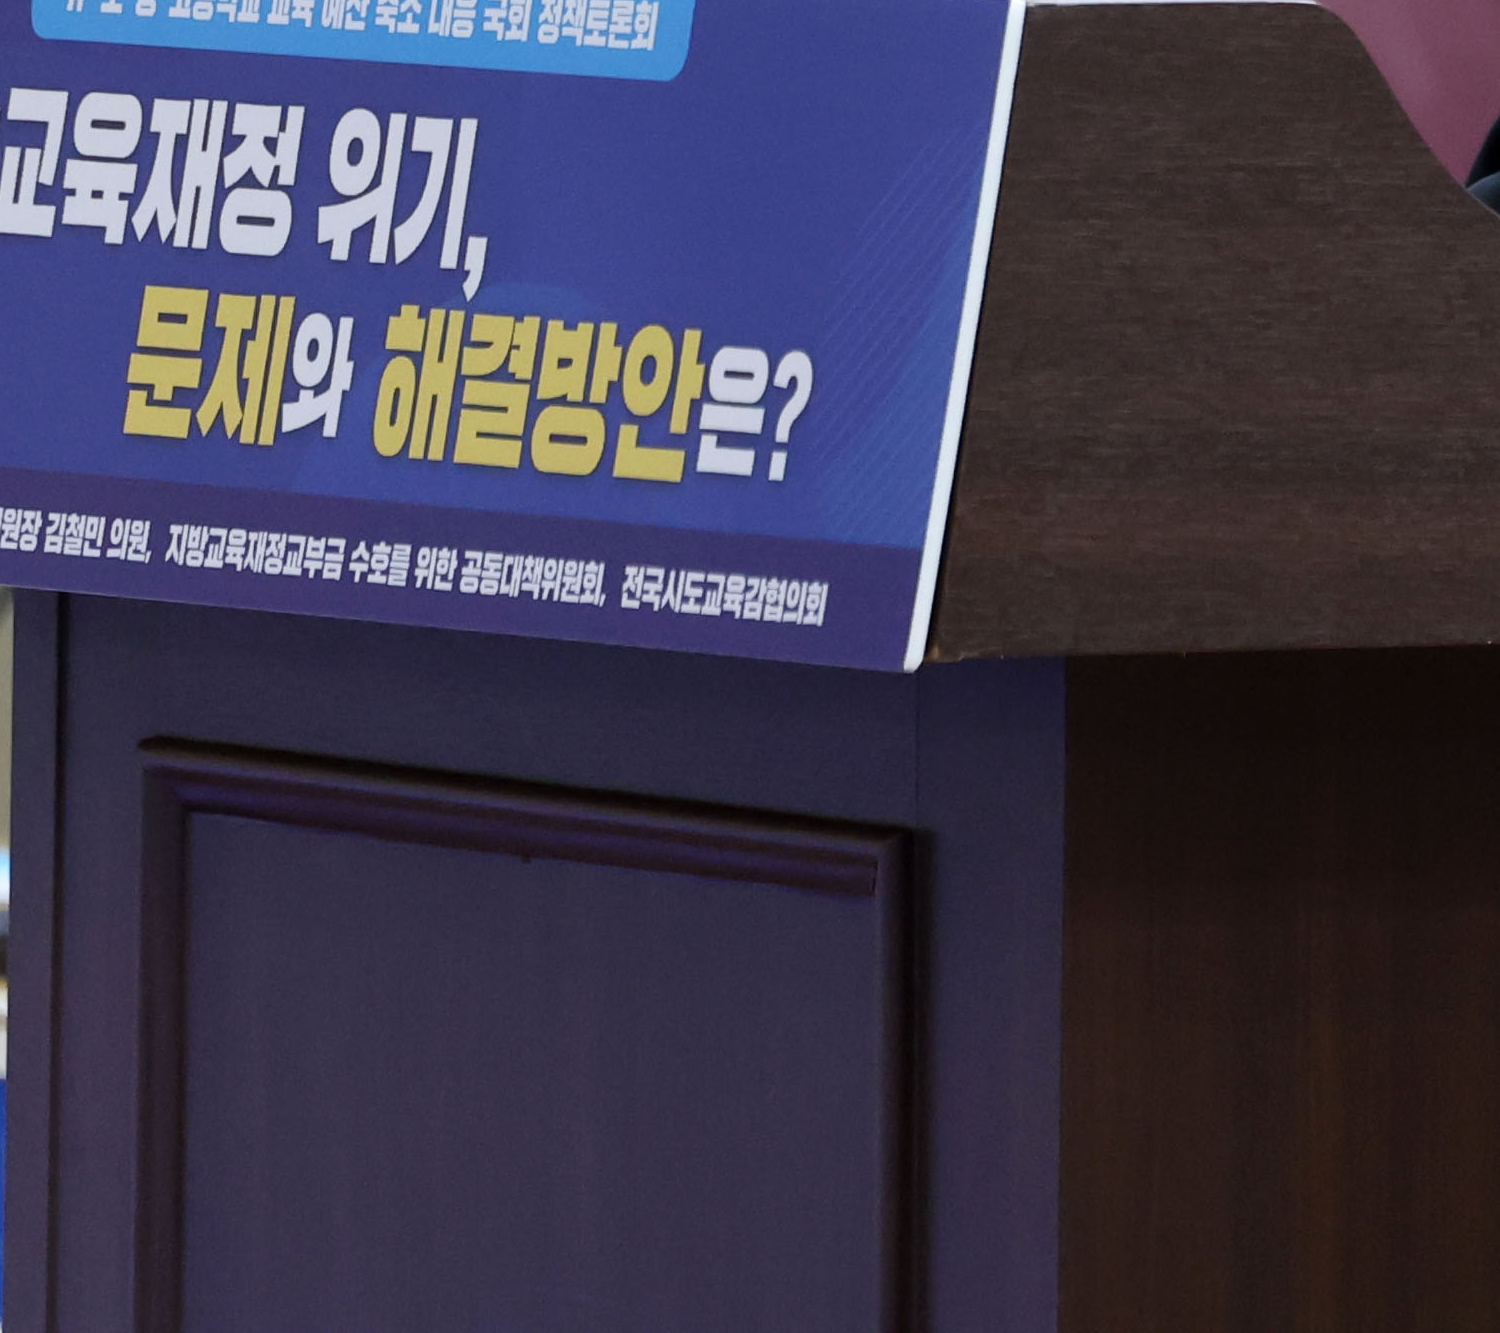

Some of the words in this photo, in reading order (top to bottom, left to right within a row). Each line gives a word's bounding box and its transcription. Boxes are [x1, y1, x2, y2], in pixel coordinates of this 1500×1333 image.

[316, 107, 489, 302] 위기,
[121, 284, 354, 447] 문제와
[371, 302, 814, 483] 해결방안은?
[43, 511, 106, 559] 김철민
[106, 516, 152, 565] 의원,
[164, 523, 347, 582] 지방교육재정교부금
[348, 539, 412, 588] 수호를
[413, 546, 459, 592] 위한
[459, 549, 607, 608] 공동대책위원회,
[620, 564, 829, 628] 전국시도교육감협의회
